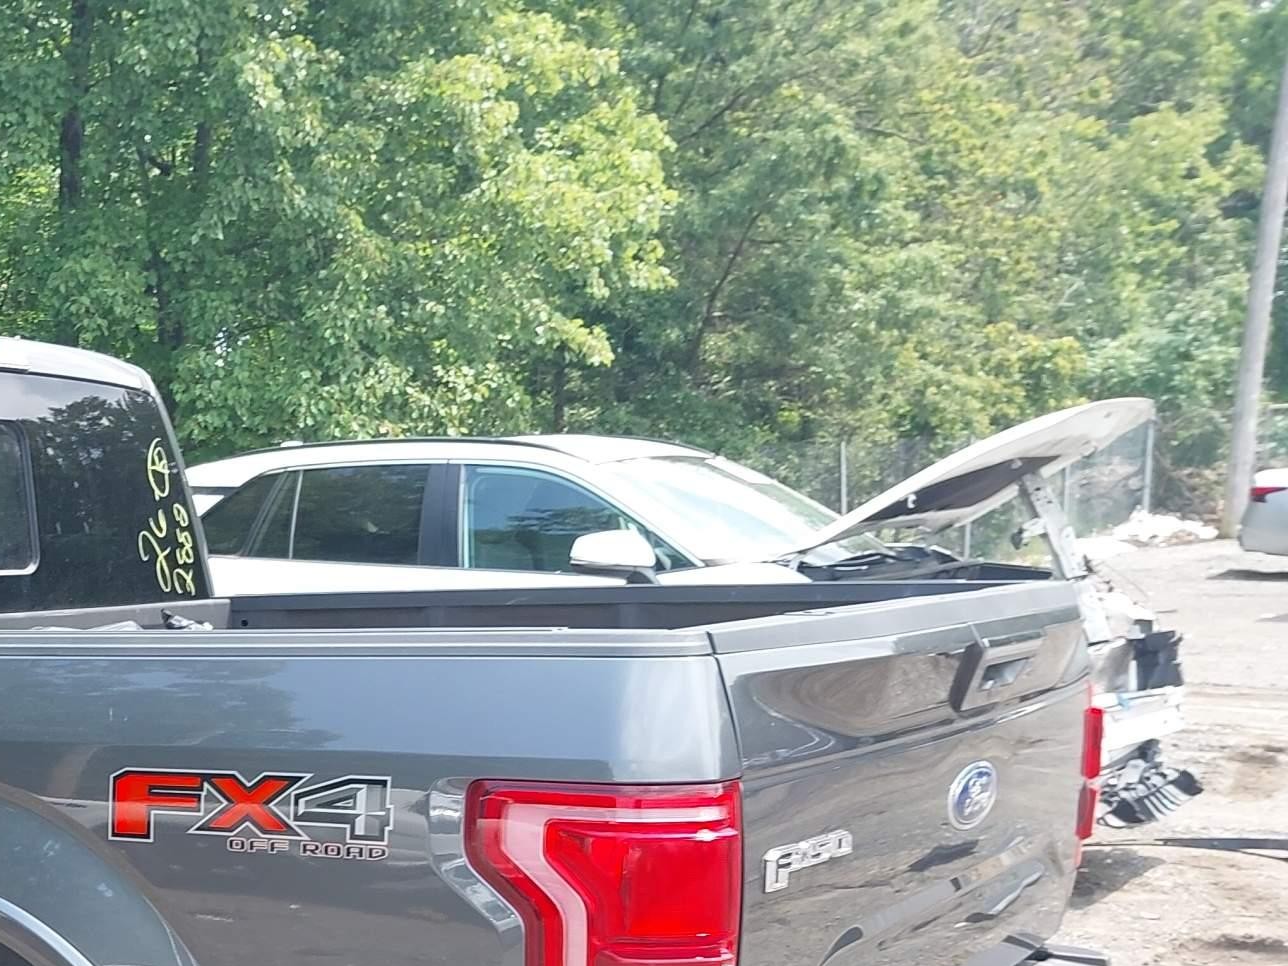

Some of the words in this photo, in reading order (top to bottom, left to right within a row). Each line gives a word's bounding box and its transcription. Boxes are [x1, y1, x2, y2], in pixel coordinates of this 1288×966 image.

[108, 767, 394, 845] FX4
[226, 836, 289, 854] OFF
[299, 842, 389, 861] ROAD
